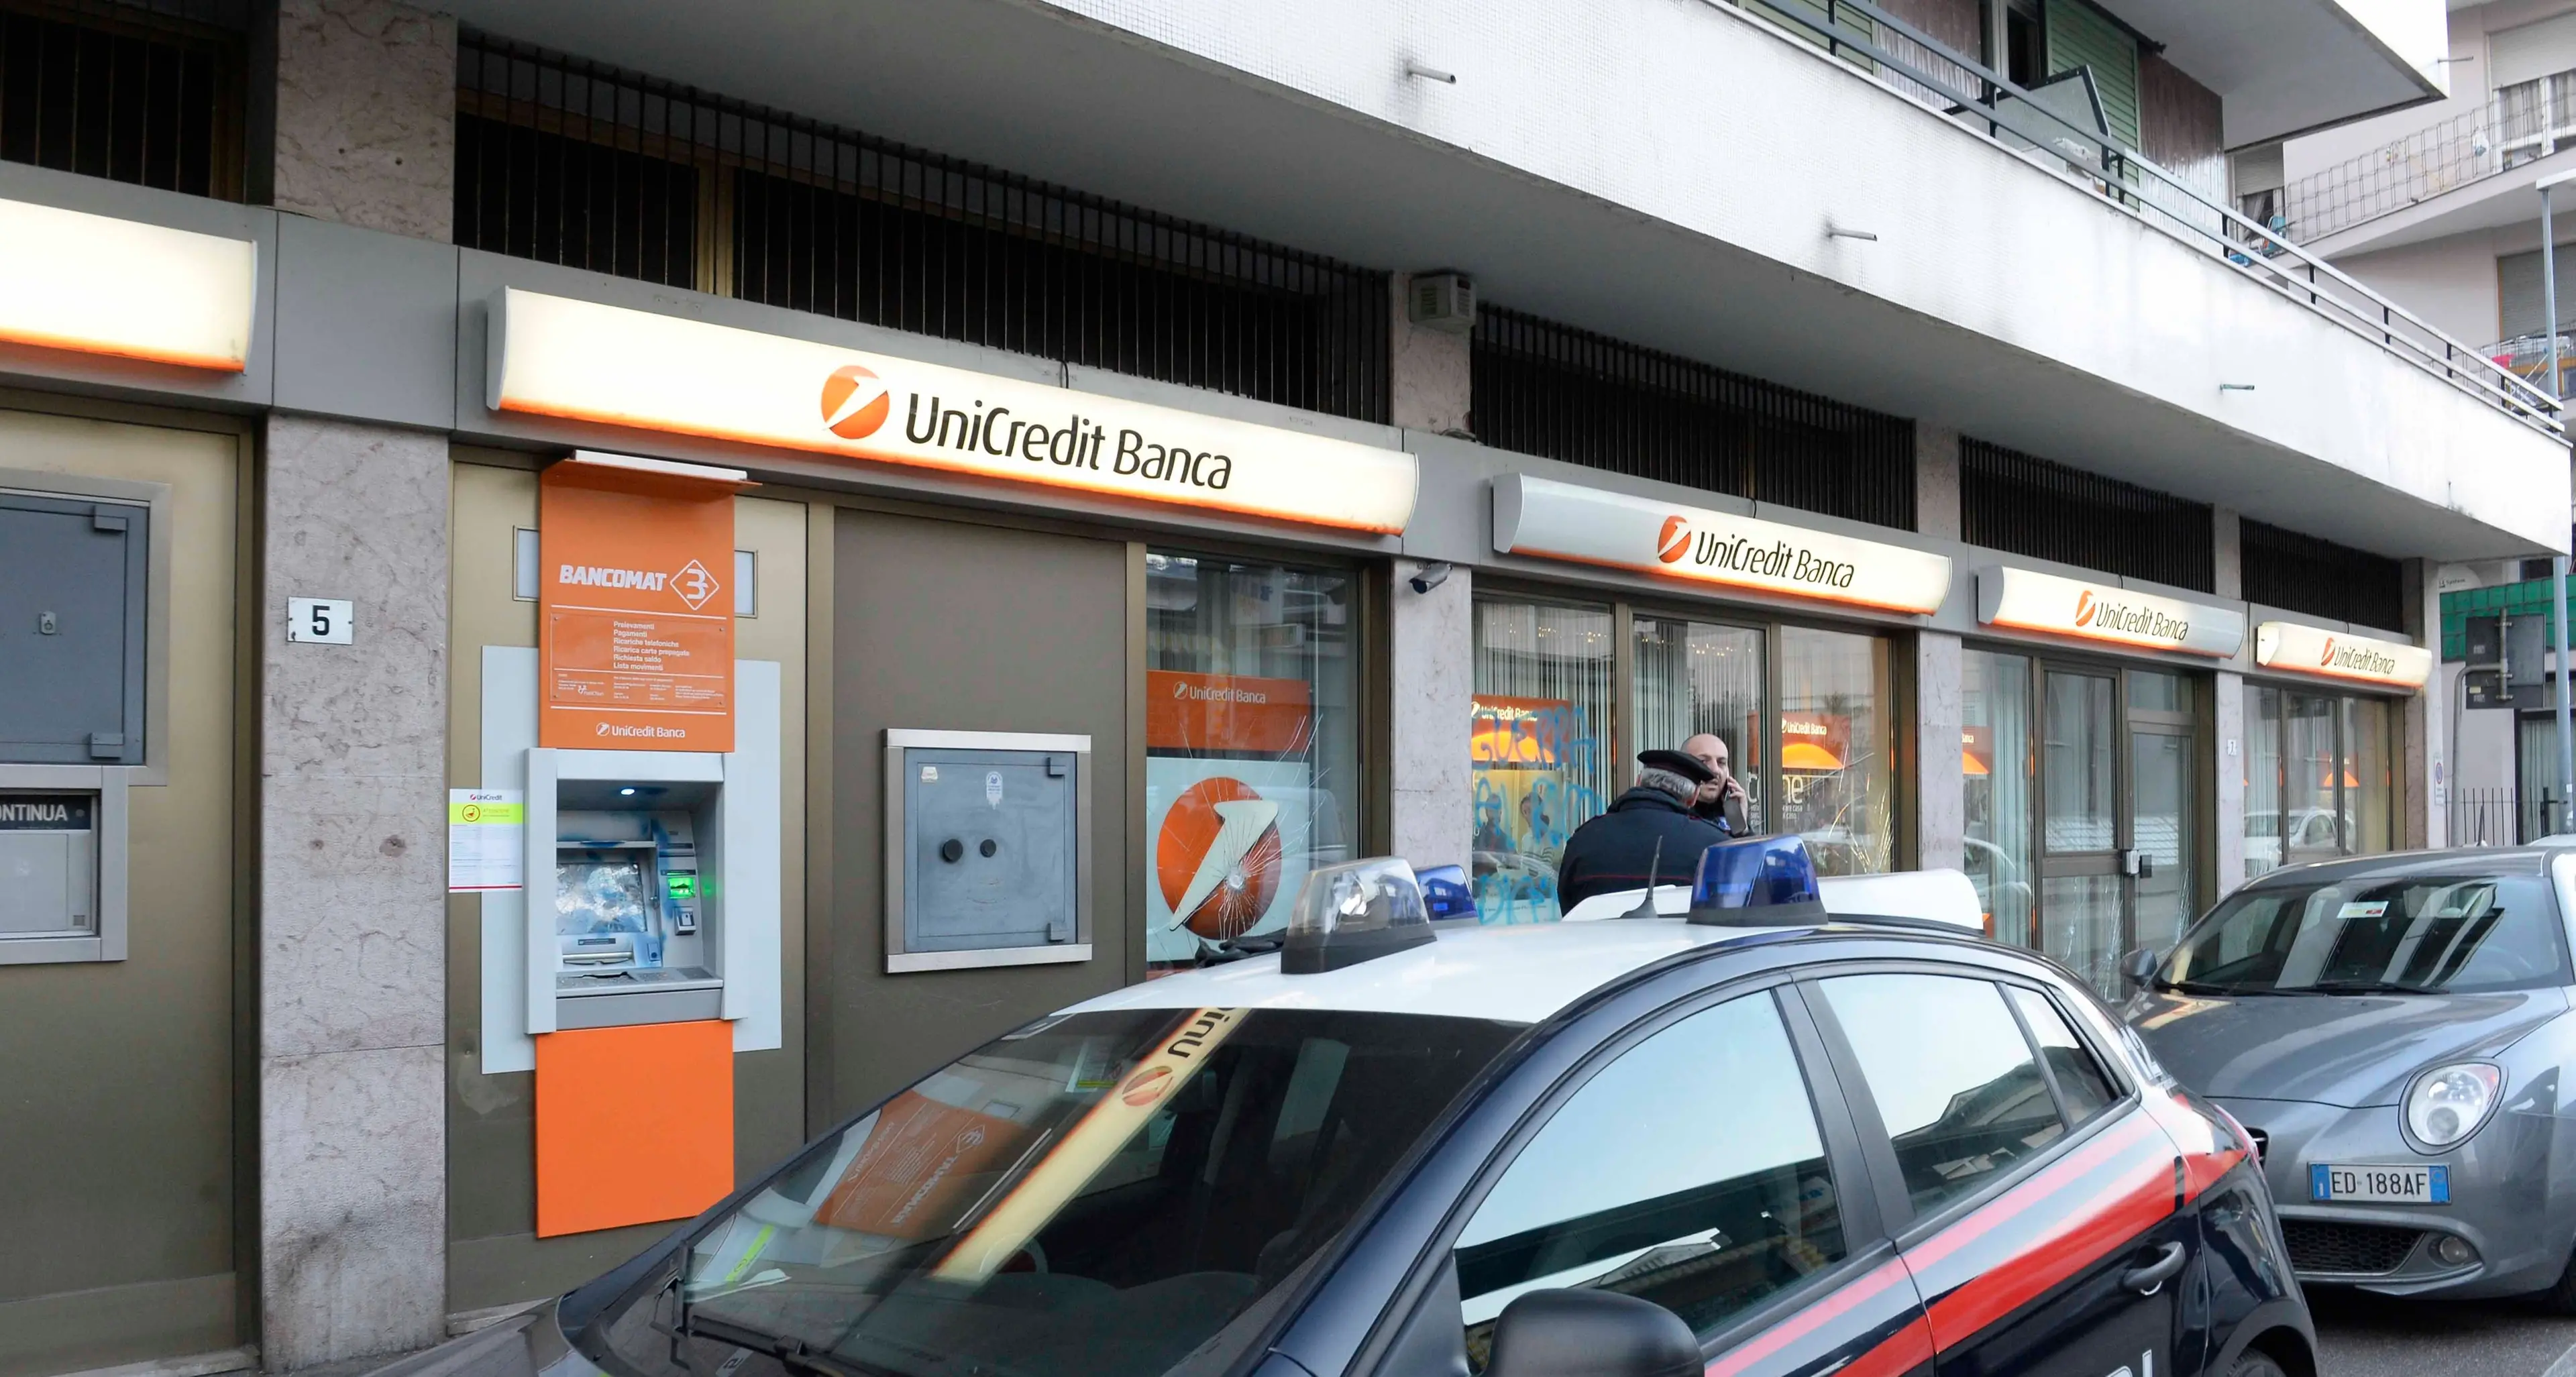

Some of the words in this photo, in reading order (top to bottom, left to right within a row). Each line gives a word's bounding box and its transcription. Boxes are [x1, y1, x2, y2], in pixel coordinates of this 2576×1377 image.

[906, 392, 1106, 470] UniCredit
[1114, 429, 1232, 489] Banca
[1695, 531, 1793, 577] UniCredit
[1793, 549, 1854, 588] Banca
[559, 565, 667, 591] BANCOMAT
[312, 605, 330, 636] 5
[614, 621, 655, 630] Prelevamenti
[2096, 602, 2153, 635] UniCredit
[2152, 612, 2189, 641] Banca
[614, 629, 647, 638] Pagamenti
[2334, 645, 2371, 671] UniCredit
[2369, 652, 2395, 675] Banca
[1190, 685, 1234, 702] UniCredit
[1236, 690, 1266, 704] Banca
[612, 725, 655, 737] UniCredit
[657, 727, 686, 738] Banca
[1787, 722, 1811, 734] UniCredit
[0, 804, 68, 822] NTINUA
[2331, 1172, 2357, 1194] ED
[2367, 1172, 2427, 1195] 188AF
